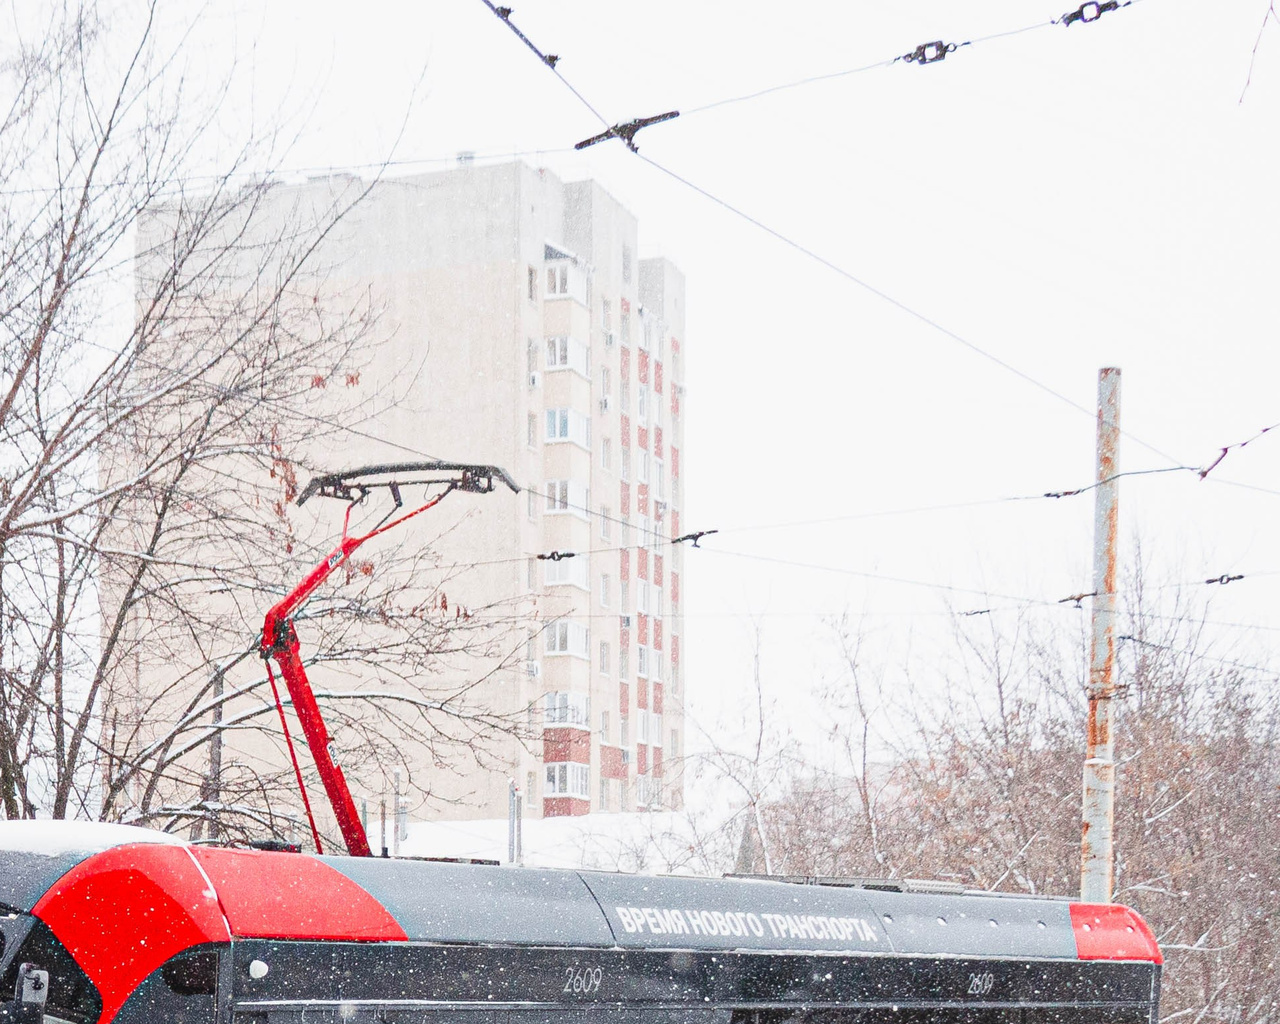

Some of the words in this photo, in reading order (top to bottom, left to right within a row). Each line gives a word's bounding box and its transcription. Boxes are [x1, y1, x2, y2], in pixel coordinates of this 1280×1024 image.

[615, 906, 690, 934] ВРЕМЯ
[685, 909, 764, 938] НОВОГО
[761, 913, 878, 942] ТРАНСПОРТА
[563, 967, 603, 993] 2609
